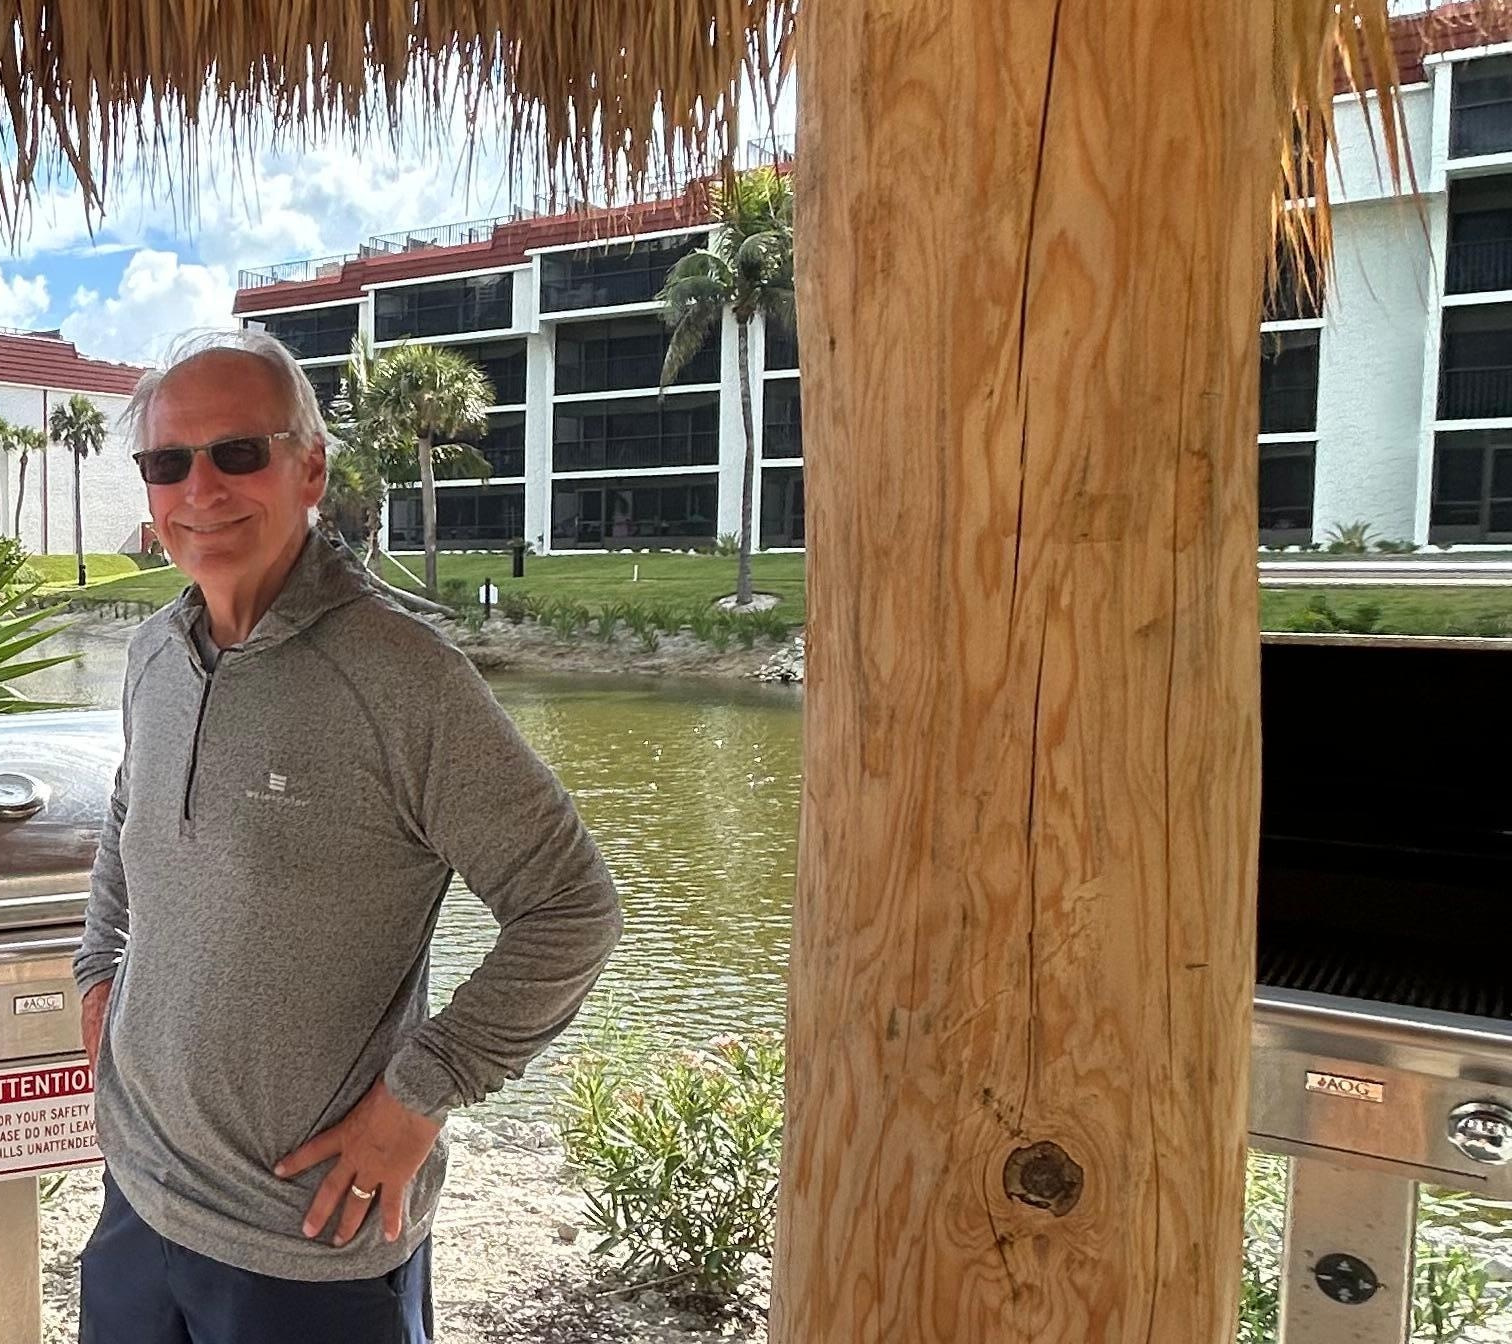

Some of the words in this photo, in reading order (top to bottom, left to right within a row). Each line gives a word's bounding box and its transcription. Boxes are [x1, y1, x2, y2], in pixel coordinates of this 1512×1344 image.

[29, 996, 57, 1010] AOG
[1328, 1078, 1370, 1096] AOG
[16, 1110, 46, 1124] YOUR
[50, 1104, 90, 1120] SAFETY
[24, 1127, 40, 1140] DO
[44, 1123, 65, 1137] NOT
[69, 1119, 96, 1133] LEAV
[27, 1135, 96, 1155] UNATTENDED
